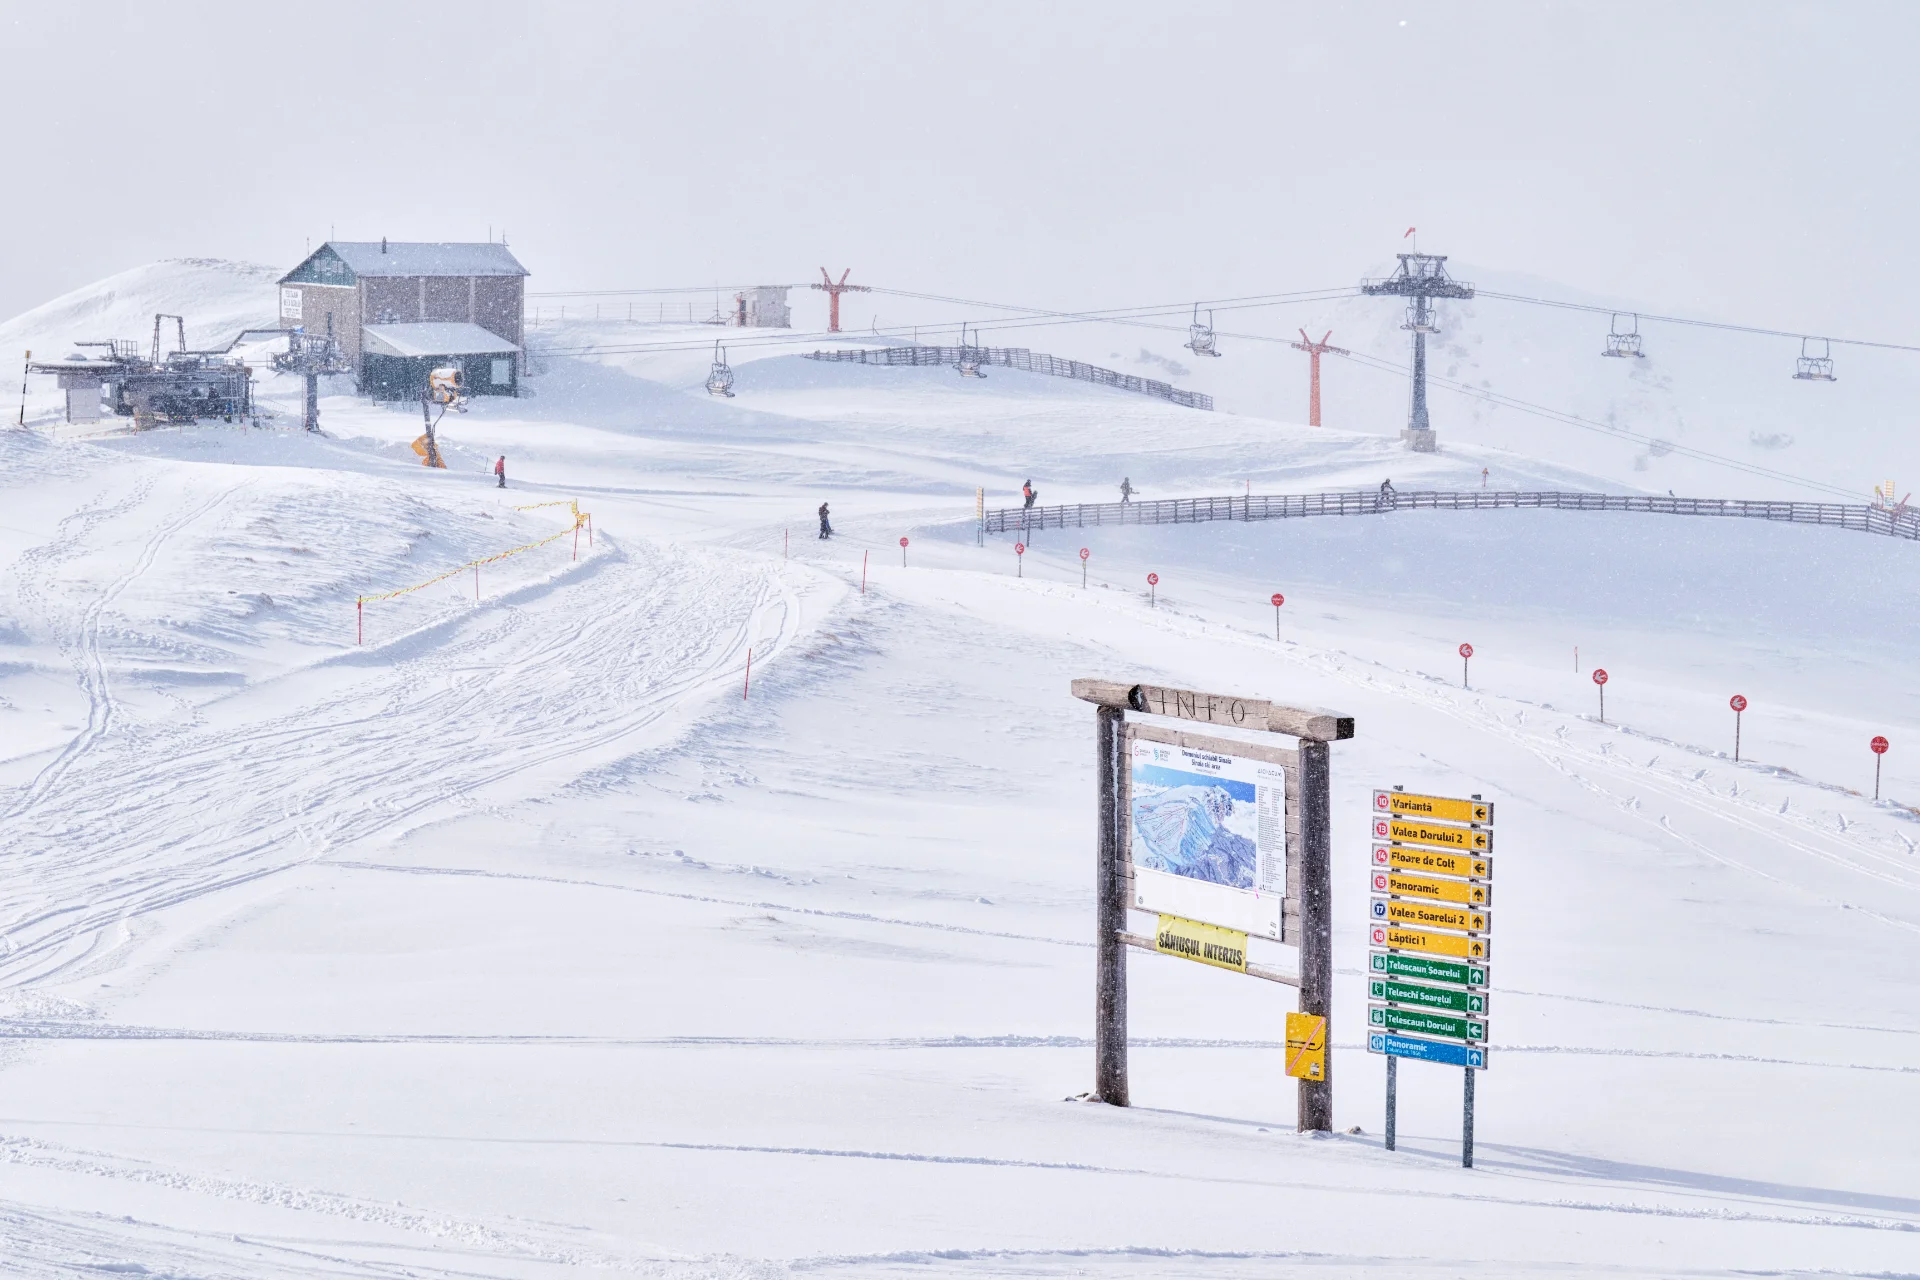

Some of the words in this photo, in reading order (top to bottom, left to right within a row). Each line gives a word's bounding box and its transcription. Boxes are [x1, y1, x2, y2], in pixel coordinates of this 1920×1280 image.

[1161, 690, 1245, 724] INFO
[1378, 796, 1387, 806] 10
[1393, 798, 1432, 812] Variantă
[1393, 826, 1417, 838] Valea
[1420, 830, 1454, 843] Dorului
[1457, 834, 1463, 844] 2
[1377, 851, 1386, 860] 14
[1392, 852, 1420, 864] Floare
[1423, 856, 1434, 866] de
[1436, 858, 1455, 871] Colț
[1376, 877, 1385, 886] 15
[1390, 880, 1439, 894] Panoramic
[1376, 905, 1384, 914] 17
[1390, 907, 1416, 918] Valea
[1418, 911, 1456, 923] Soarelui
[1459, 916, 1464, 925] 2
[1375, 932, 1383, 940] 18
[1389, 932, 1419, 945] Lăptici
[1422, 937, 1426, 945] 1
[1204, 942, 1242, 966] INTERZIS
[1389, 960, 1426, 972] Telescaun
[1388, 988, 1418, 999] Teleschi
[1420, 992, 1451, 1004] Soarelui
[1387, 1015, 1425, 1027] Telescaun
[1427, 1021, 1455, 1031] Dorului
[1387, 1039, 1427, 1051] Panoramic
